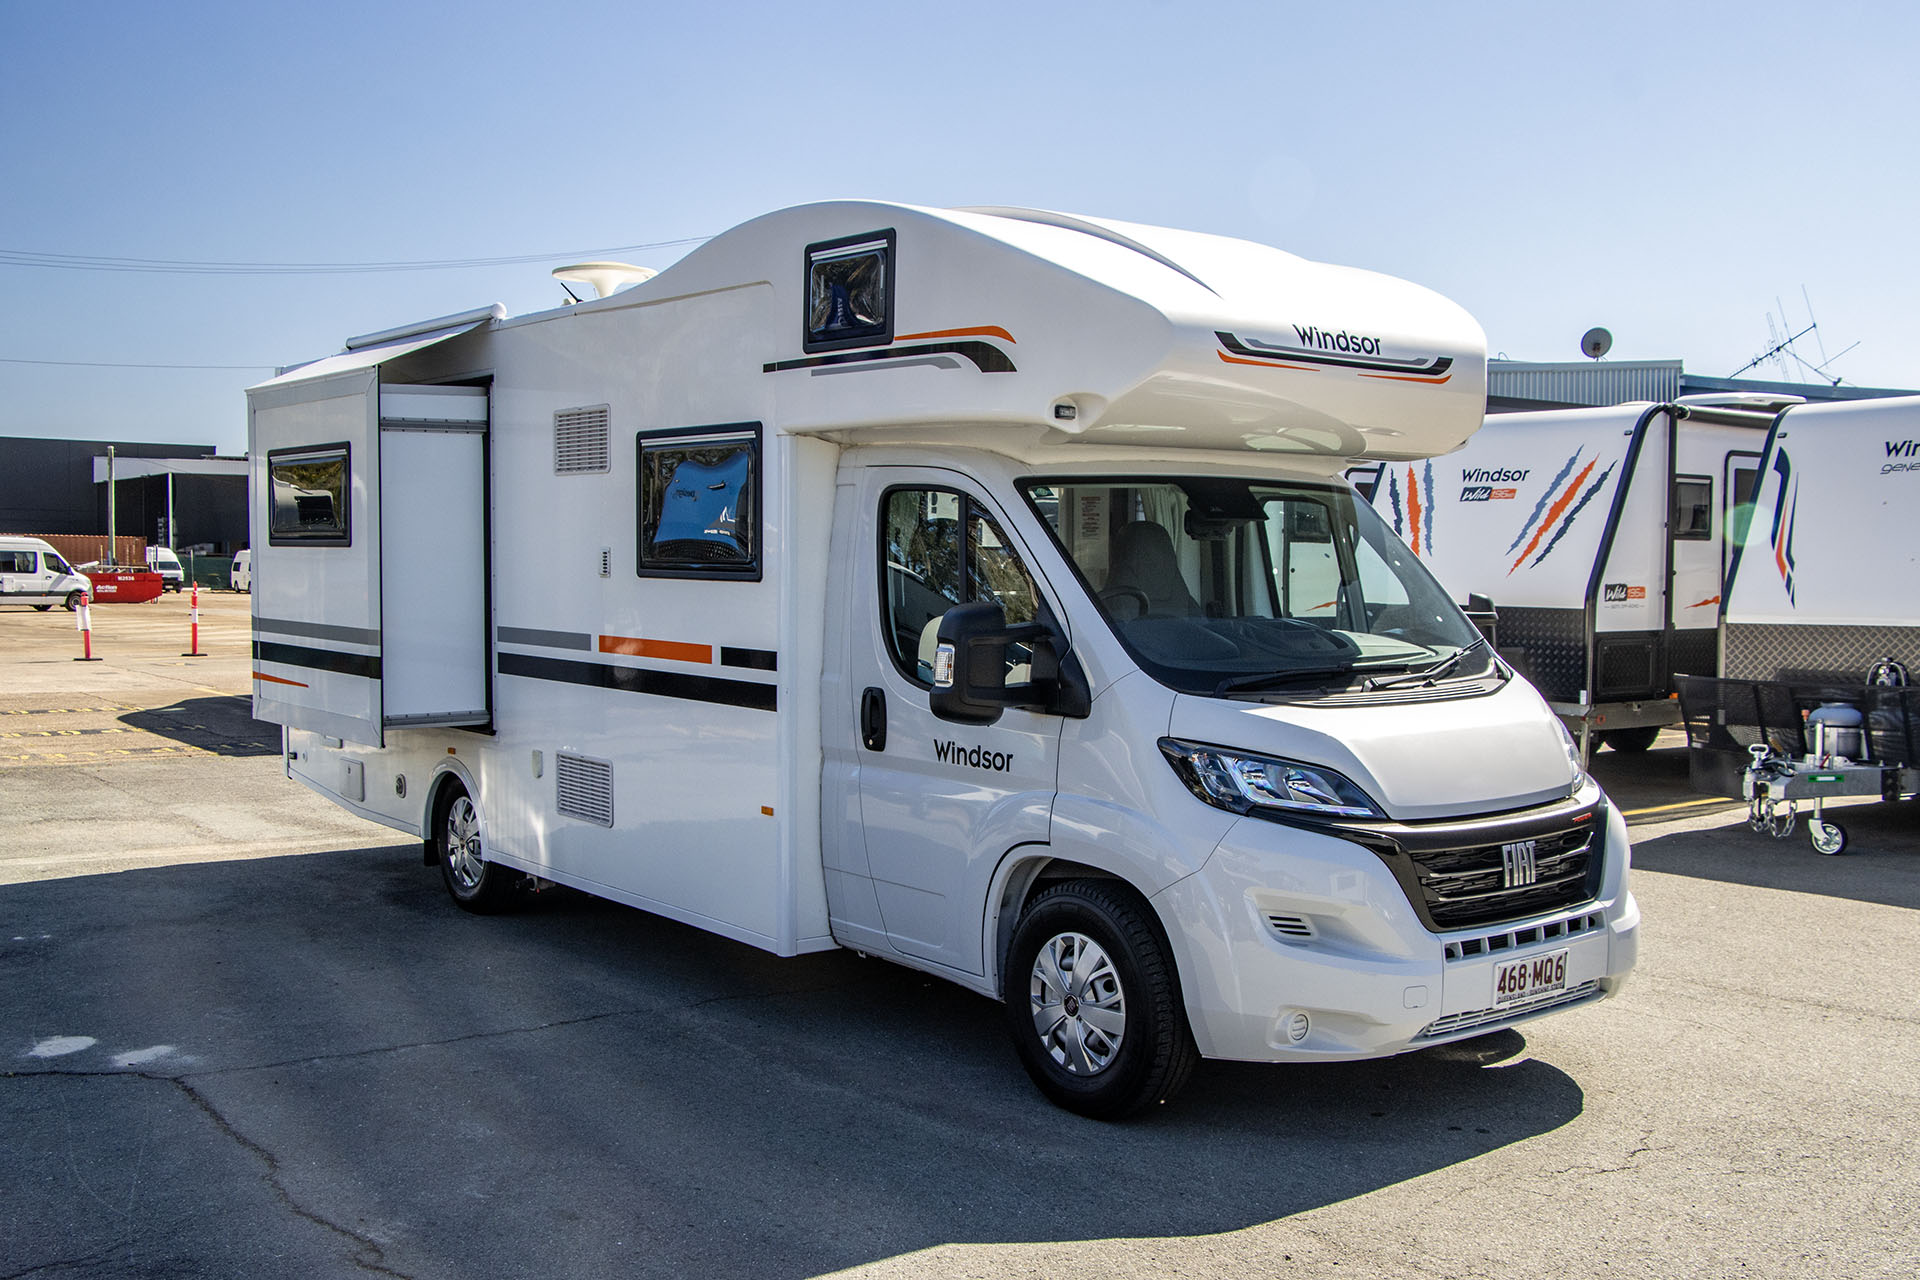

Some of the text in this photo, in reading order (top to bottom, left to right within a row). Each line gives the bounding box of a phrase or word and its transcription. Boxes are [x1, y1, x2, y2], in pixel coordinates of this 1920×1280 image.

[1292, 323, 1380, 355] Windsor
[1462, 467, 1530, 482] Windsor
[1461, 487, 1491, 500] Wild
[1606, 585, 1627, 600] Wild
[933, 738, 1014, 773] Windsor
[1502, 841, 1536, 888] FIAT
